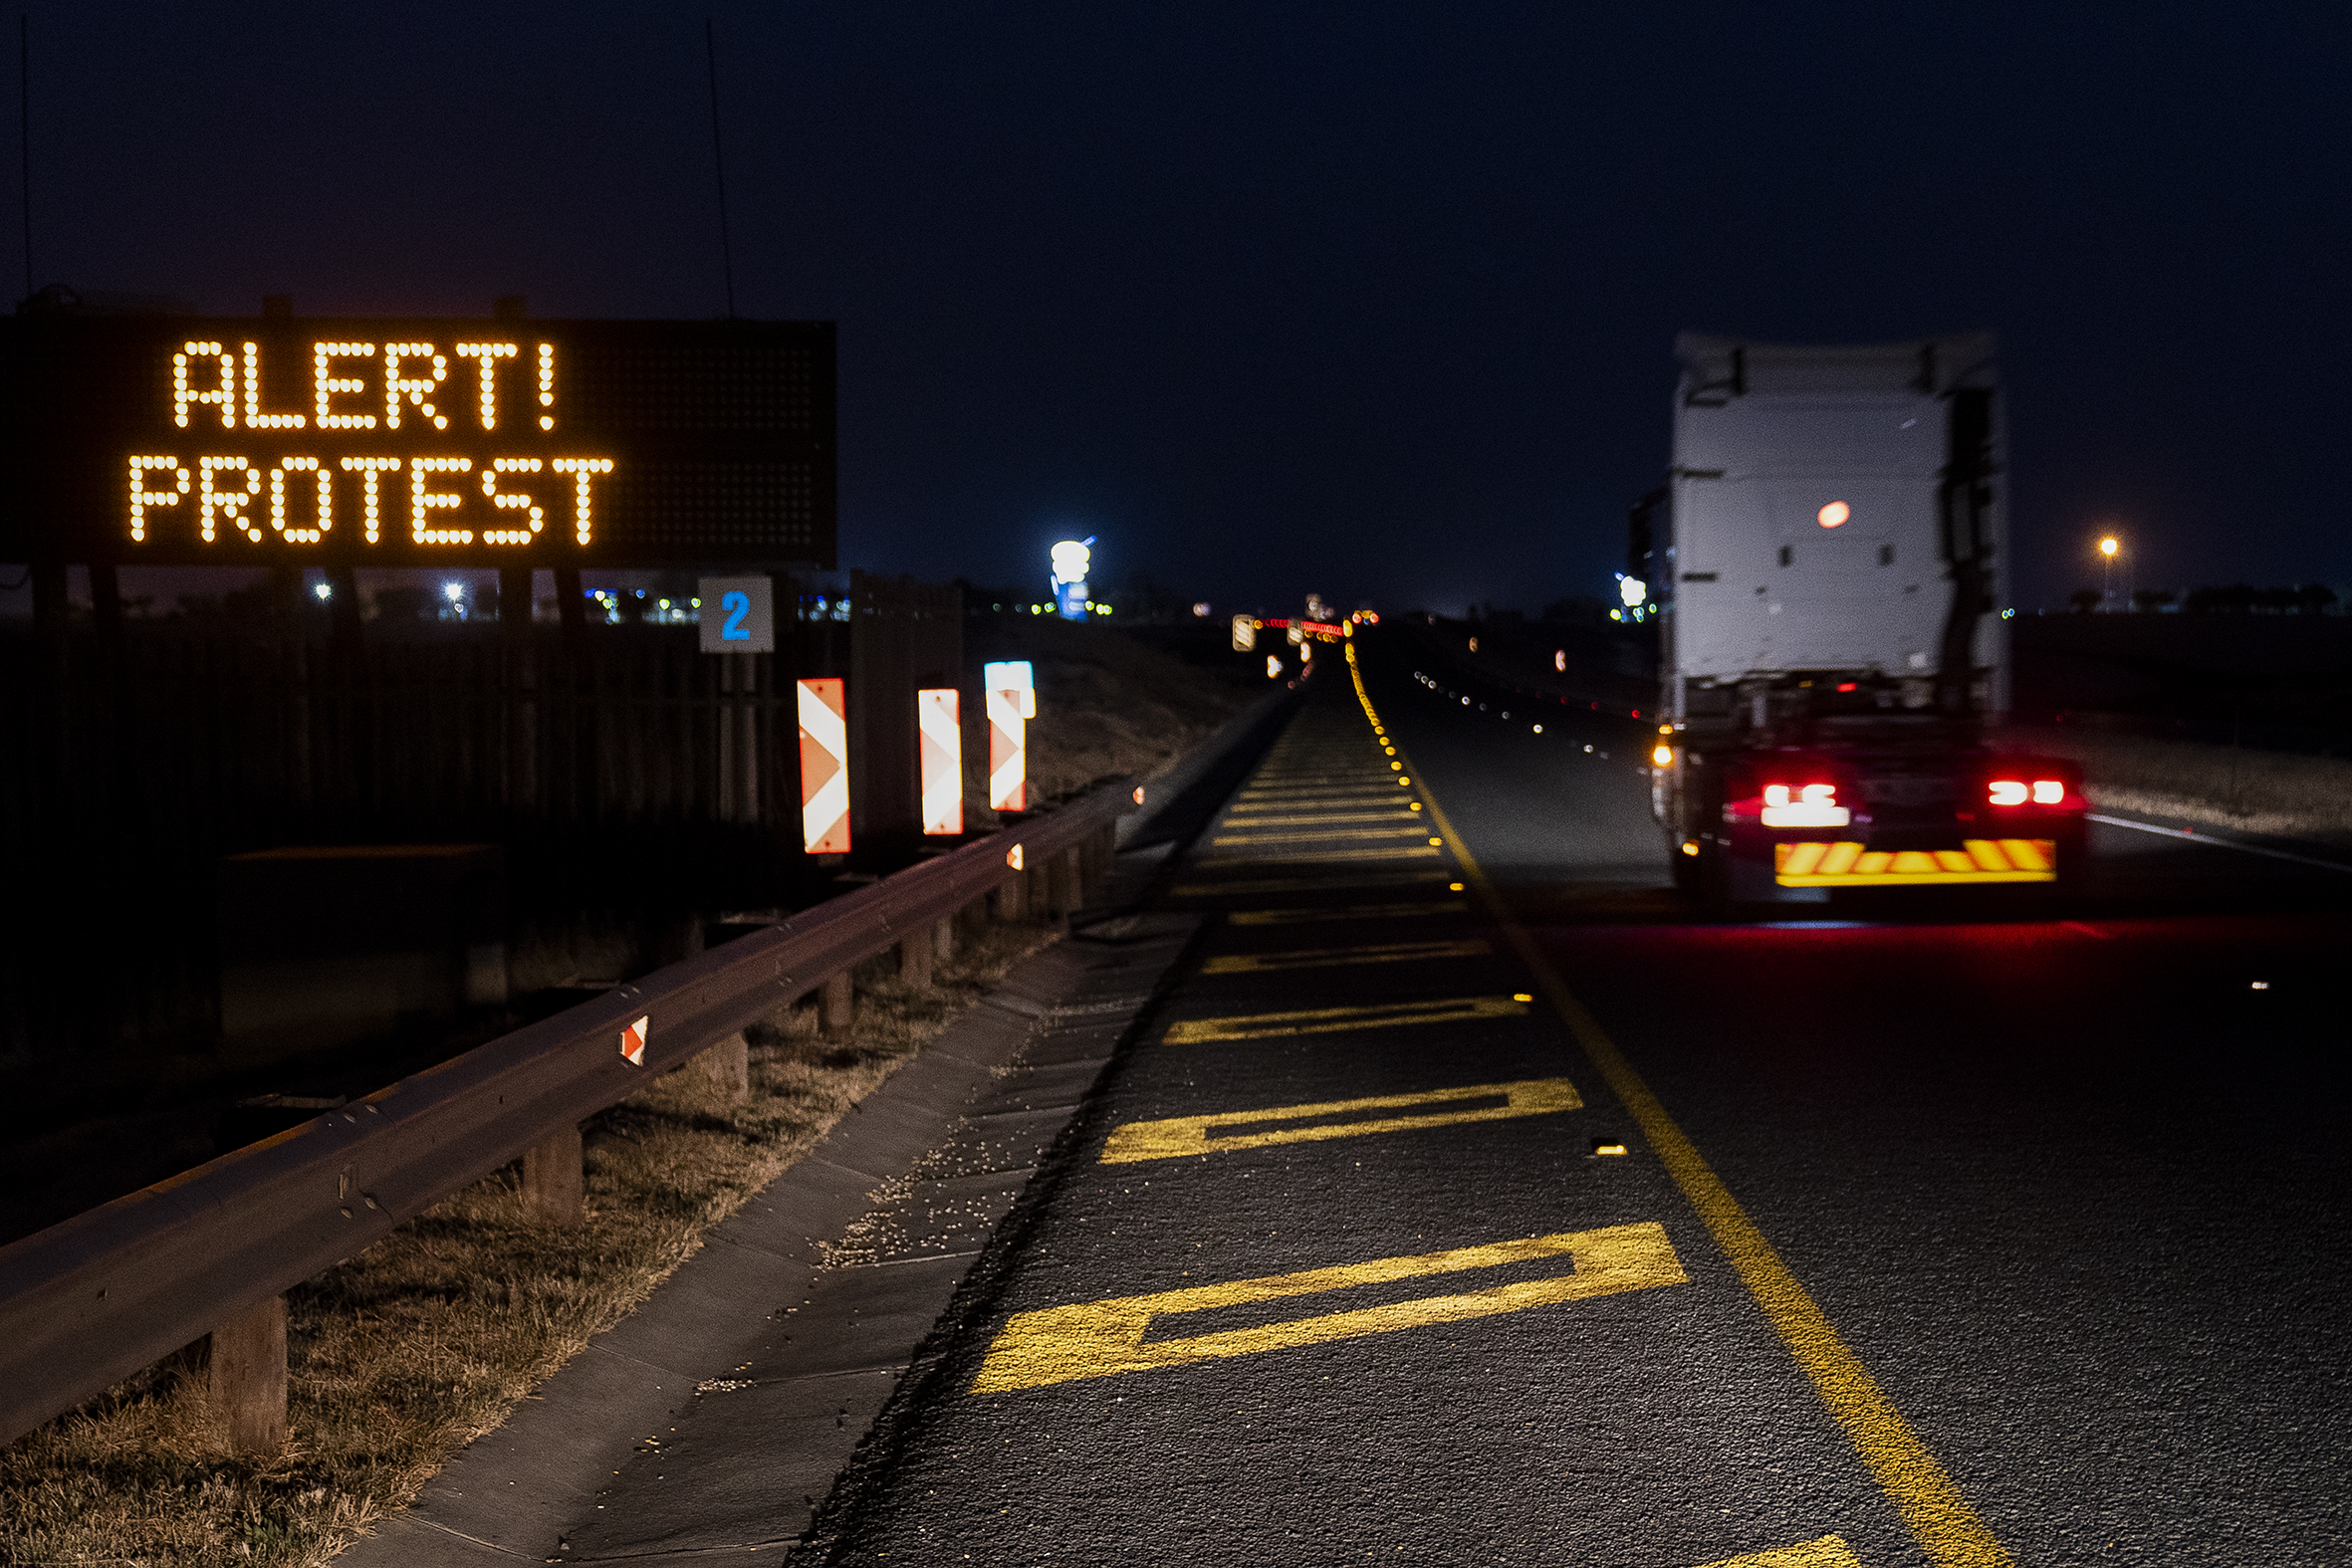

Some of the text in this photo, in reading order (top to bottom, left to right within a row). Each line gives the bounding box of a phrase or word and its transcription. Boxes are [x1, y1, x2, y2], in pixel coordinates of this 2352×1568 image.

[173, 340, 555, 431] ALERT!
[129, 454, 614, 545] PROTEST
[721, 590, 750, 640] 2
